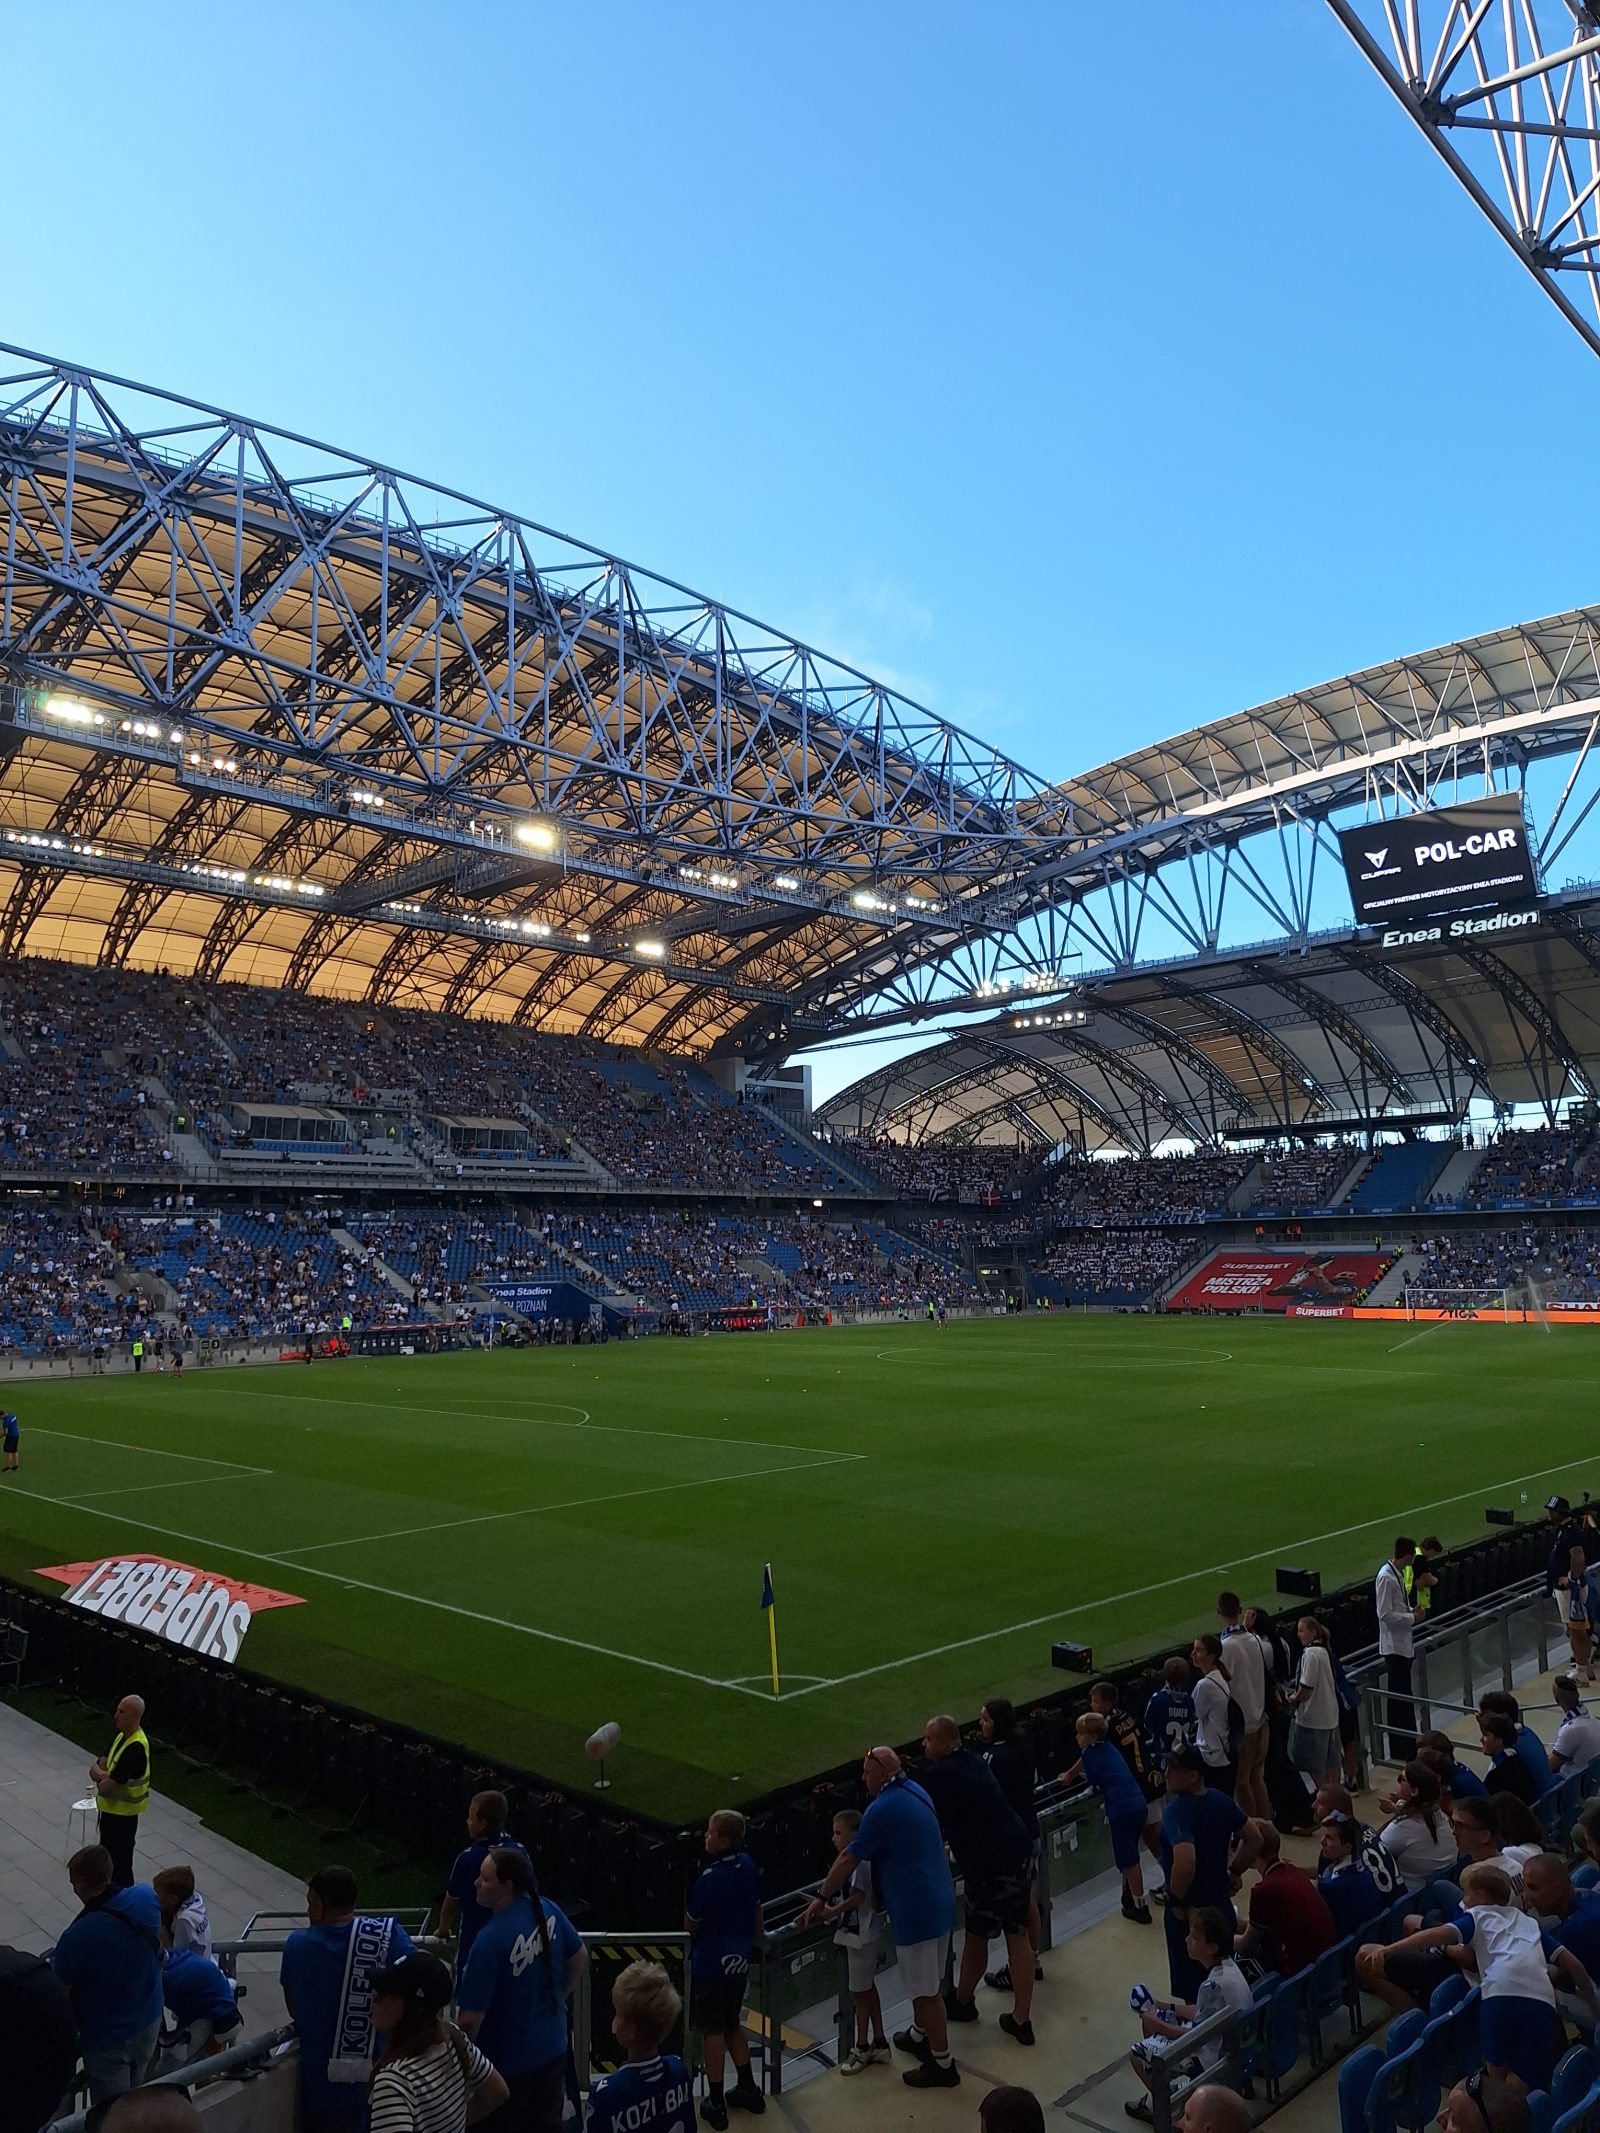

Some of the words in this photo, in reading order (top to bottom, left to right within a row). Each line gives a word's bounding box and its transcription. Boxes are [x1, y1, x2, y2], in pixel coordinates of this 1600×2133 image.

[1415, 828, 1517, 866] POL-CAR
[1382, 927, 1441, 948] Enea
[1449, 911, 1538, 937] Stadion
[1221, 1262, 1292, 1270] SUPERBET
[1205, 1277, 1274, 1286] MISTRZA
[516, 1287, 552, 1296] Stadion
[516, 1297, 547, 1313] POZNAŃ
[1295, 1306, 1344, 1318] SUPERBET
[68, 1561, 252, 1664] SUPERBET
